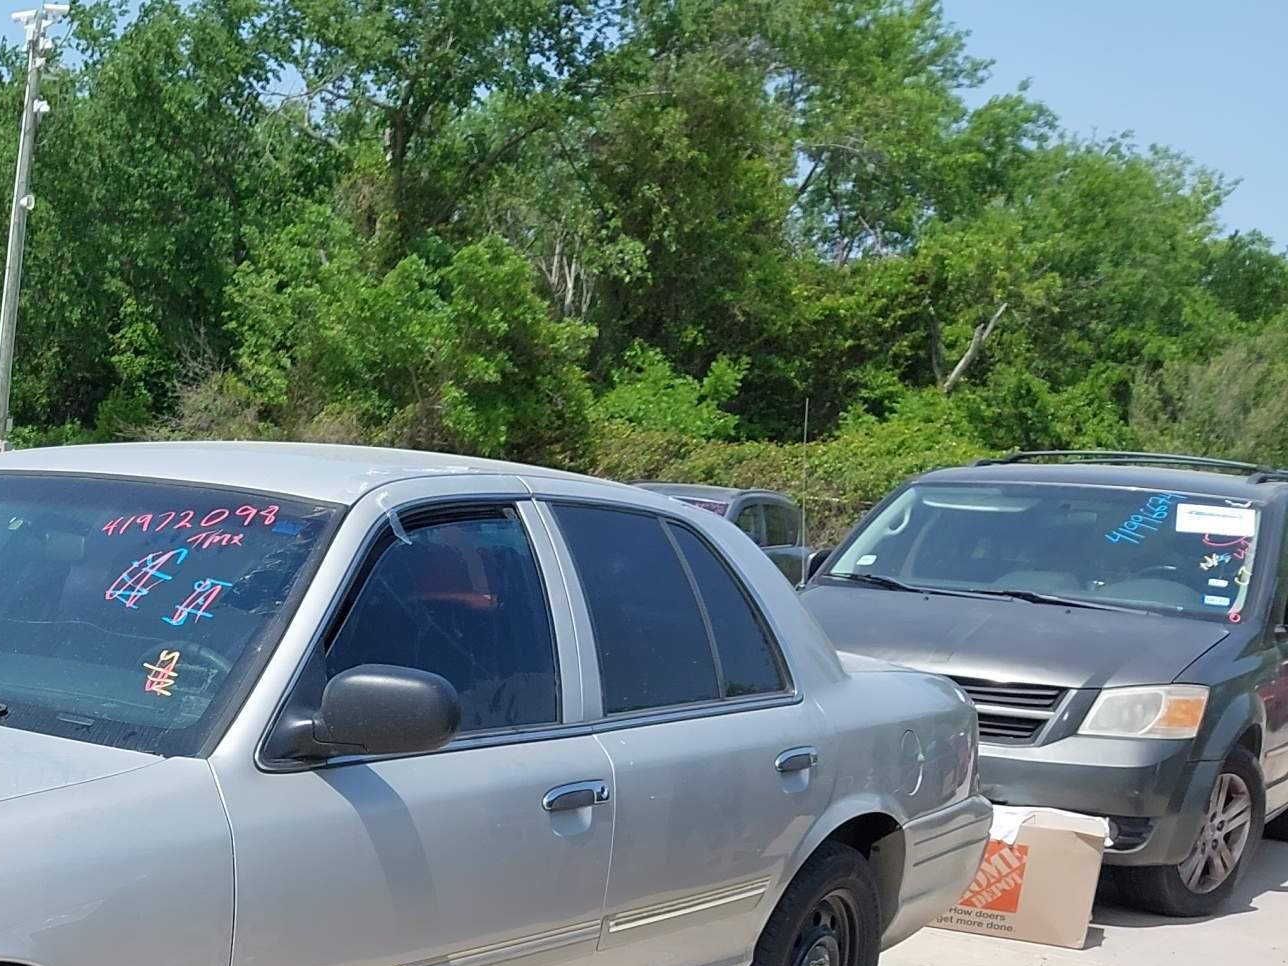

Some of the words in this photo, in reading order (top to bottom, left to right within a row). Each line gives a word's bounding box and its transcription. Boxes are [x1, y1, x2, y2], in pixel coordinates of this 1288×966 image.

[101, 504, 280, 537] 41972098
[971, 871, 1022, 909] DEPOT
[956, 918, 984, 928] more
[975, 910, 1006, 922] doers
